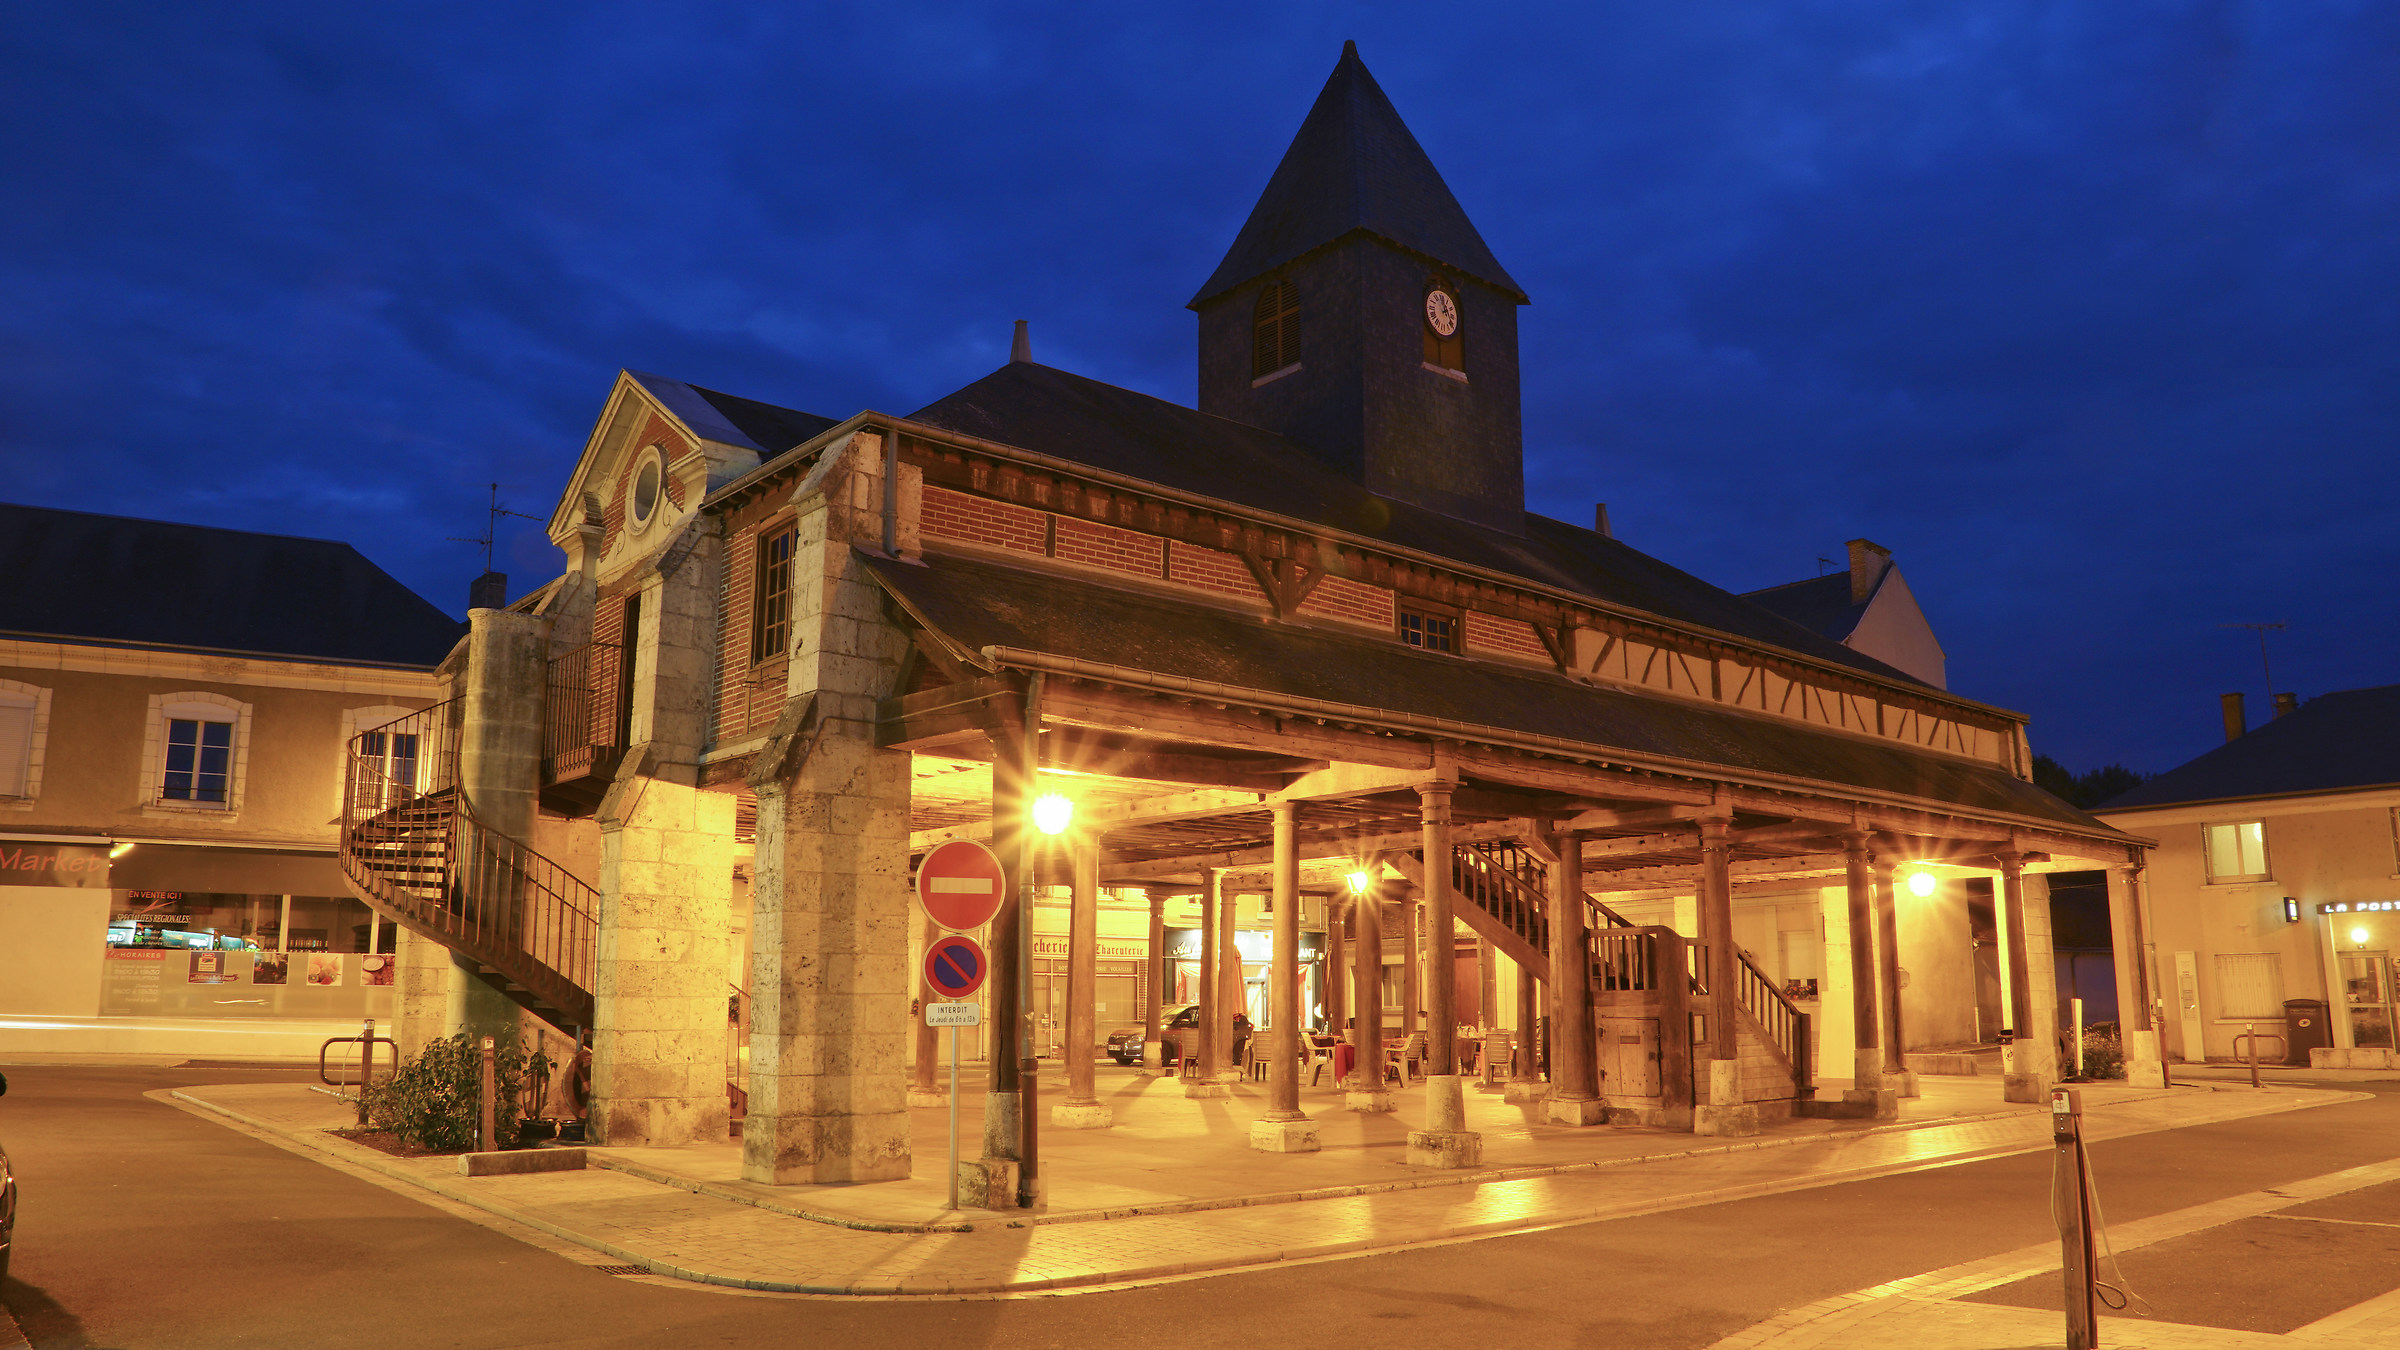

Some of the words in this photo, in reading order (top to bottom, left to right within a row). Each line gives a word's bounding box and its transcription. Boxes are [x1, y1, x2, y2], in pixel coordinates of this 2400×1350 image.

[0, 848, 101, 873] Market
[128, 890, 140, 898] EN
[141, 891, 166, 899] VENTE
[2325, 903, 2348, 913] LA
[120, 951, 161, 959] HORAIRES
